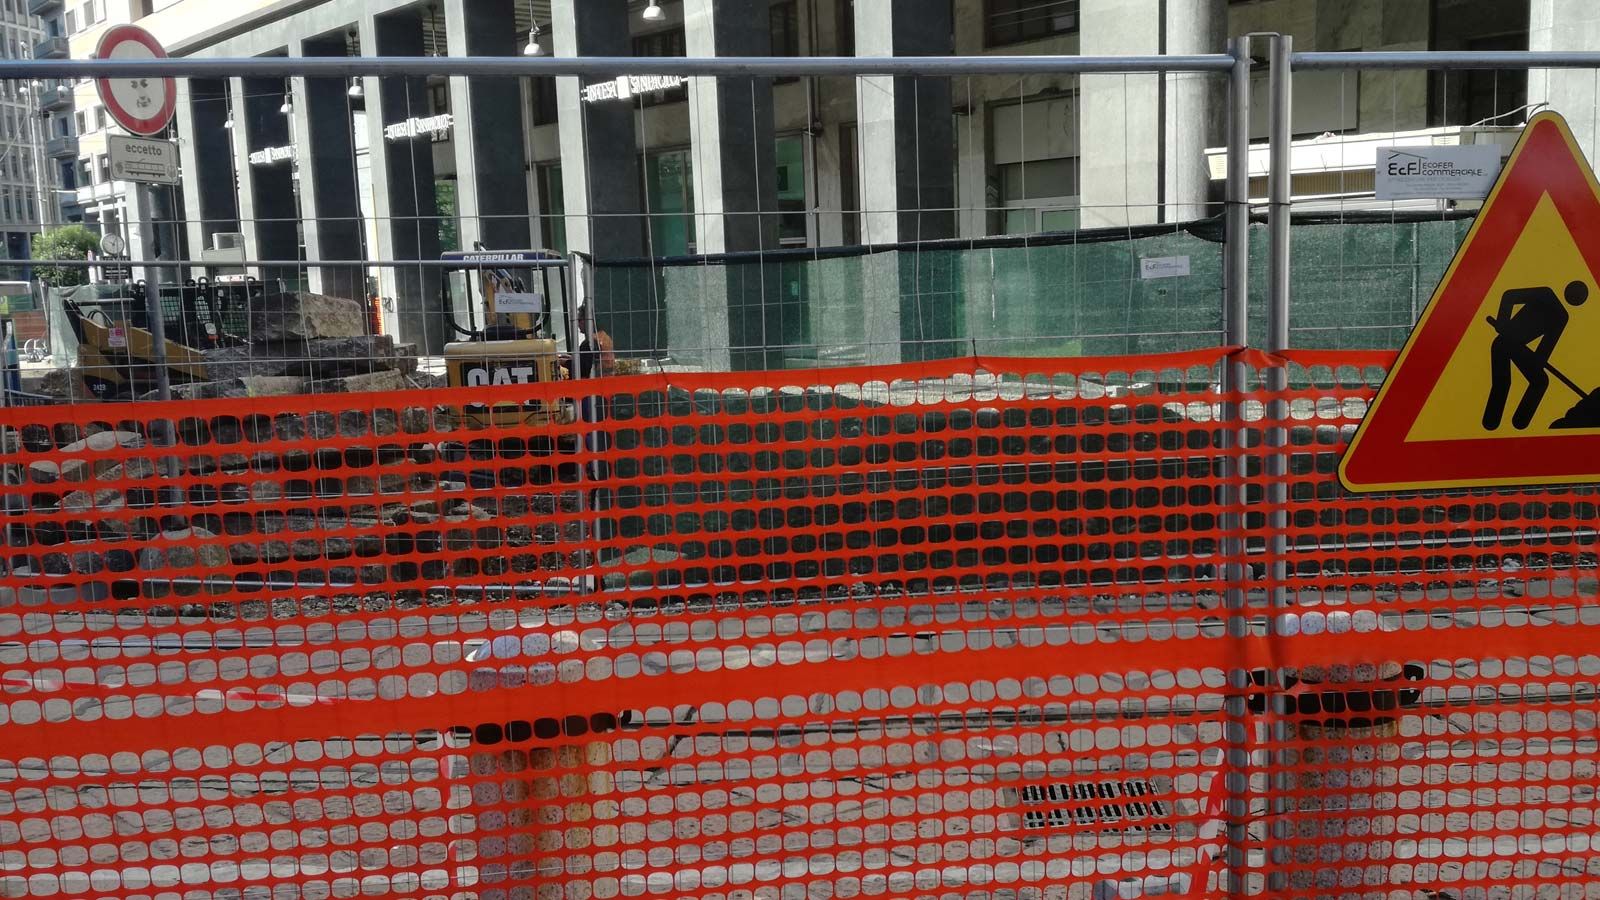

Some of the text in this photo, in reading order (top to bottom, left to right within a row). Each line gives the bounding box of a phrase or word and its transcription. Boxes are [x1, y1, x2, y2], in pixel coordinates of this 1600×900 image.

[125, 143, 163, 156] eccetto
[1422, 161, 1454, 169] ECOFER
[463, 254, 524, 262] CATERPILLAR
[467, 367, 533, 406] CAT
